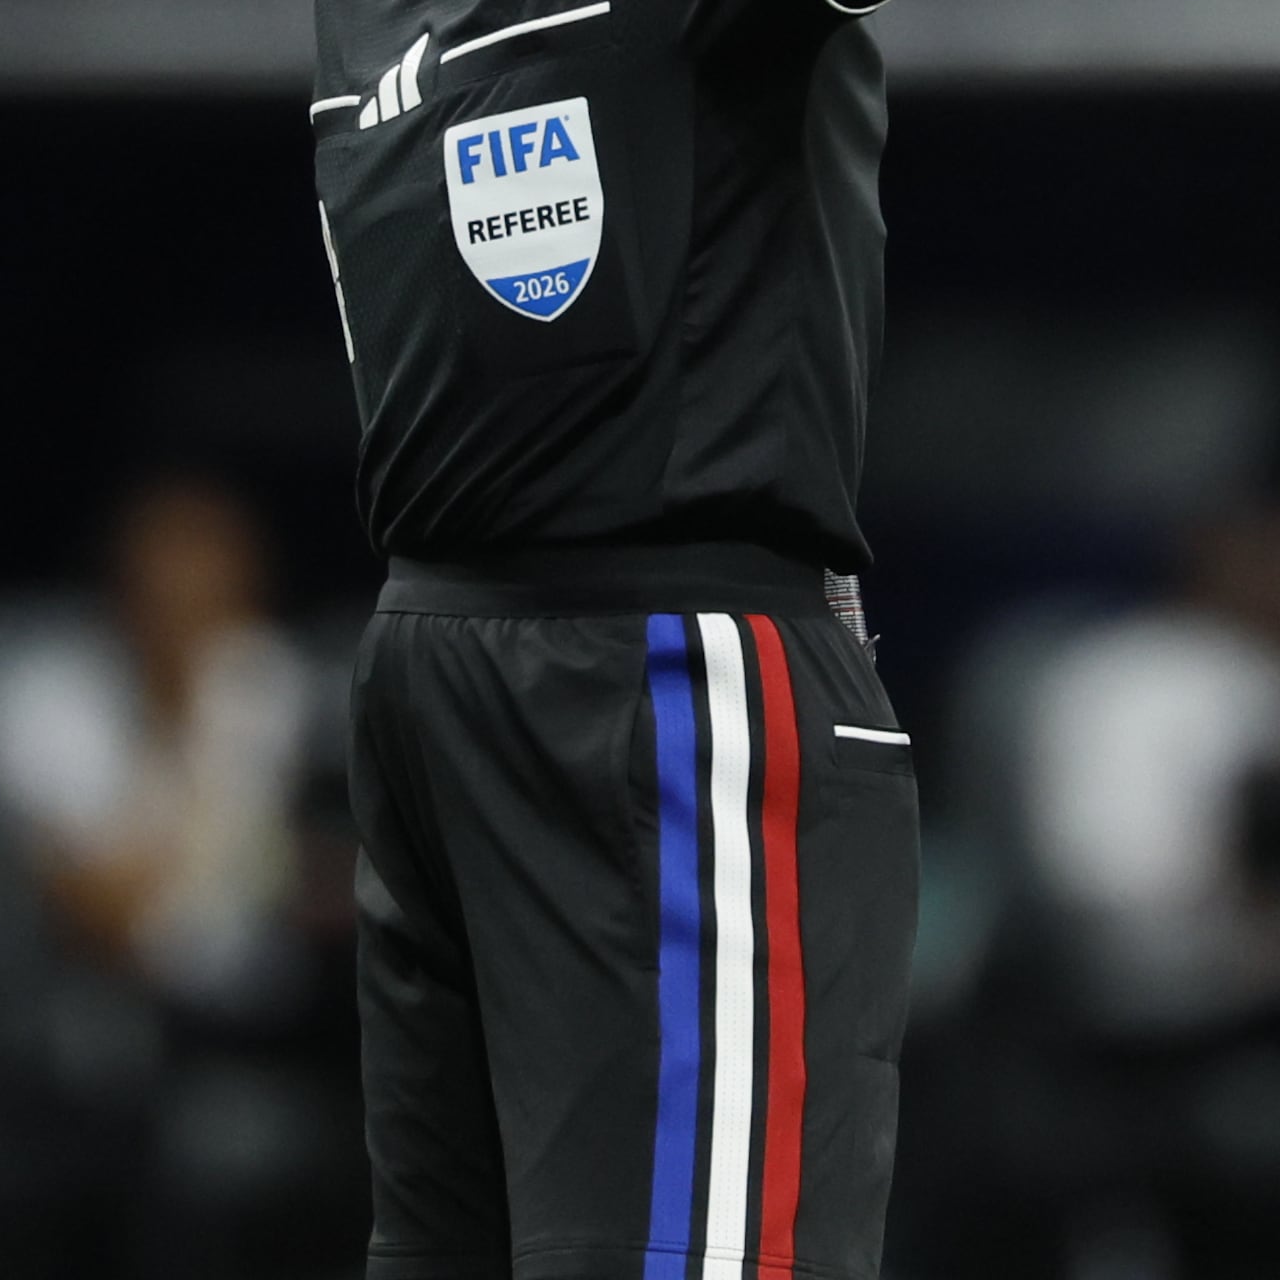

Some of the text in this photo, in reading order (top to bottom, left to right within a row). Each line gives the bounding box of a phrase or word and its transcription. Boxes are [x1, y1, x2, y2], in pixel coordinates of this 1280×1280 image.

[457, 117, 580, 184] FIFA
[468, 197, 590, 244] REFEREE
[513, 272, 570, 303] 2026
